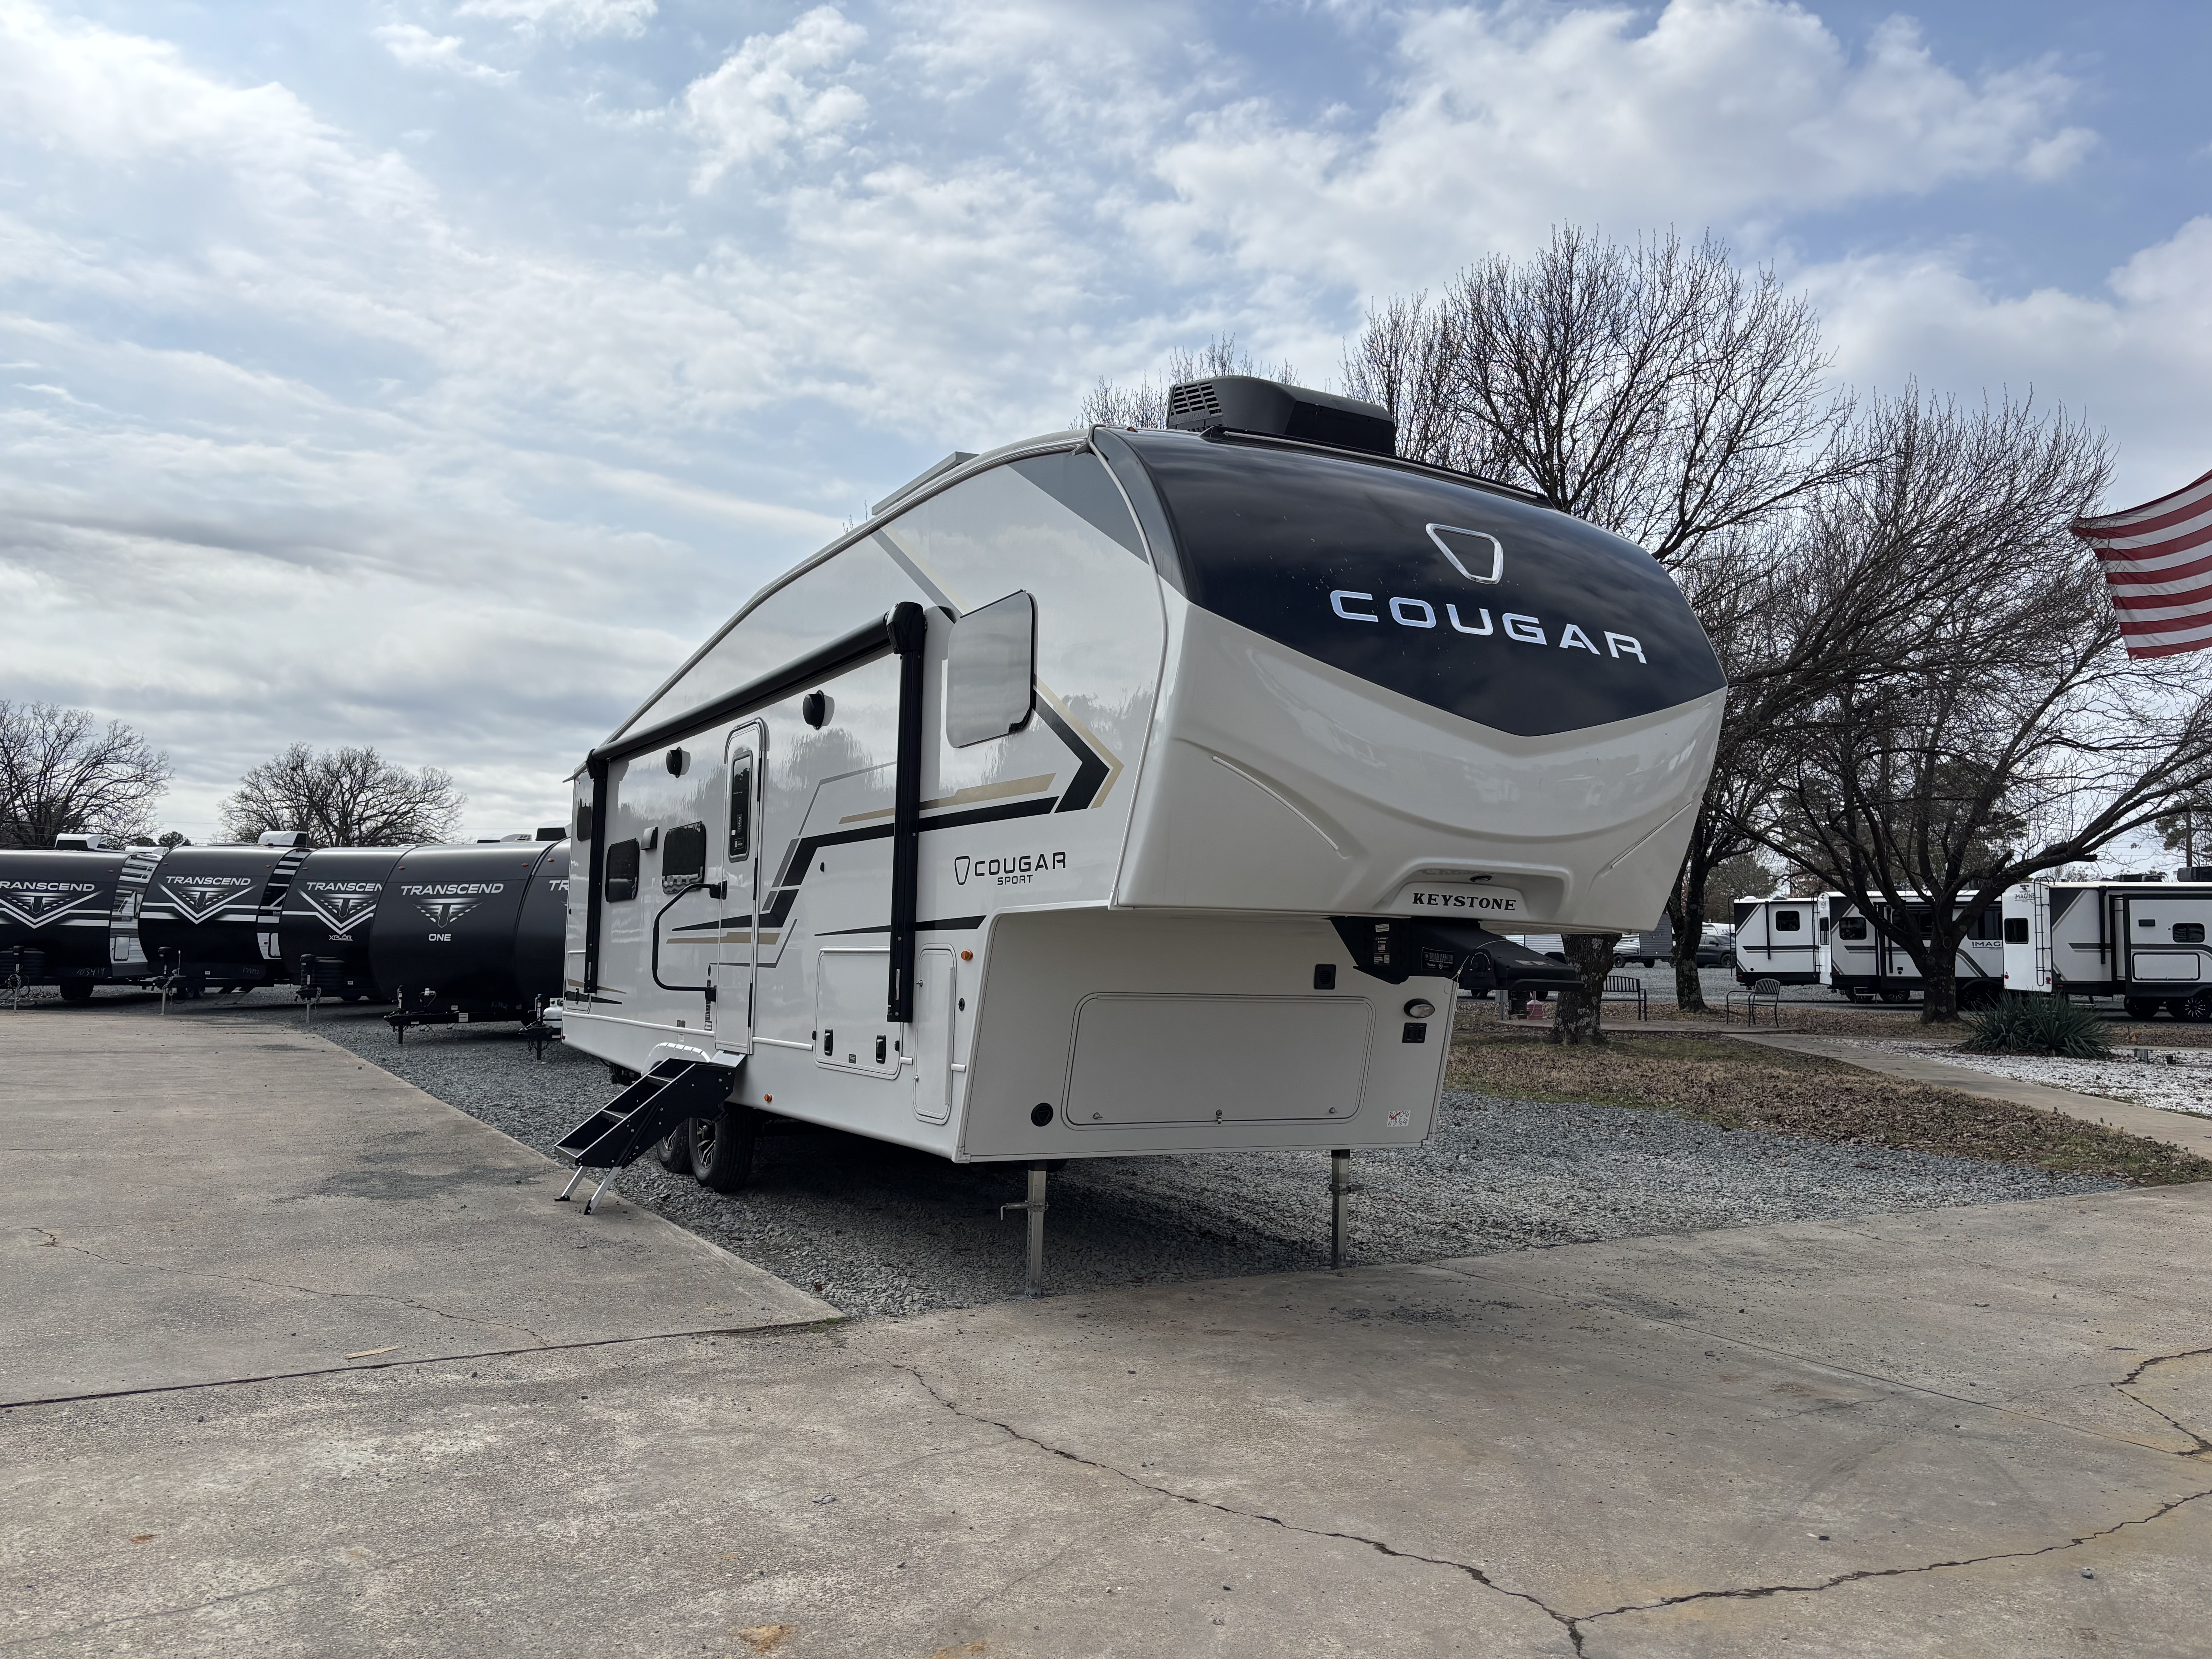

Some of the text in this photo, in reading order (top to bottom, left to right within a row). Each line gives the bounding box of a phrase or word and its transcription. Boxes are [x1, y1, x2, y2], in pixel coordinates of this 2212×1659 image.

[1330, 590, 1647, 664] COUGAR
[974, 852, 1066, 876] COUGAR
[166, 876, 251, 886] TRANSCEND
[997, 874, 1033, 885] SPORT
[400, 883, 504, 895] TRANSCEND
[1412, 893, 1516, 910] KEYSTONE
